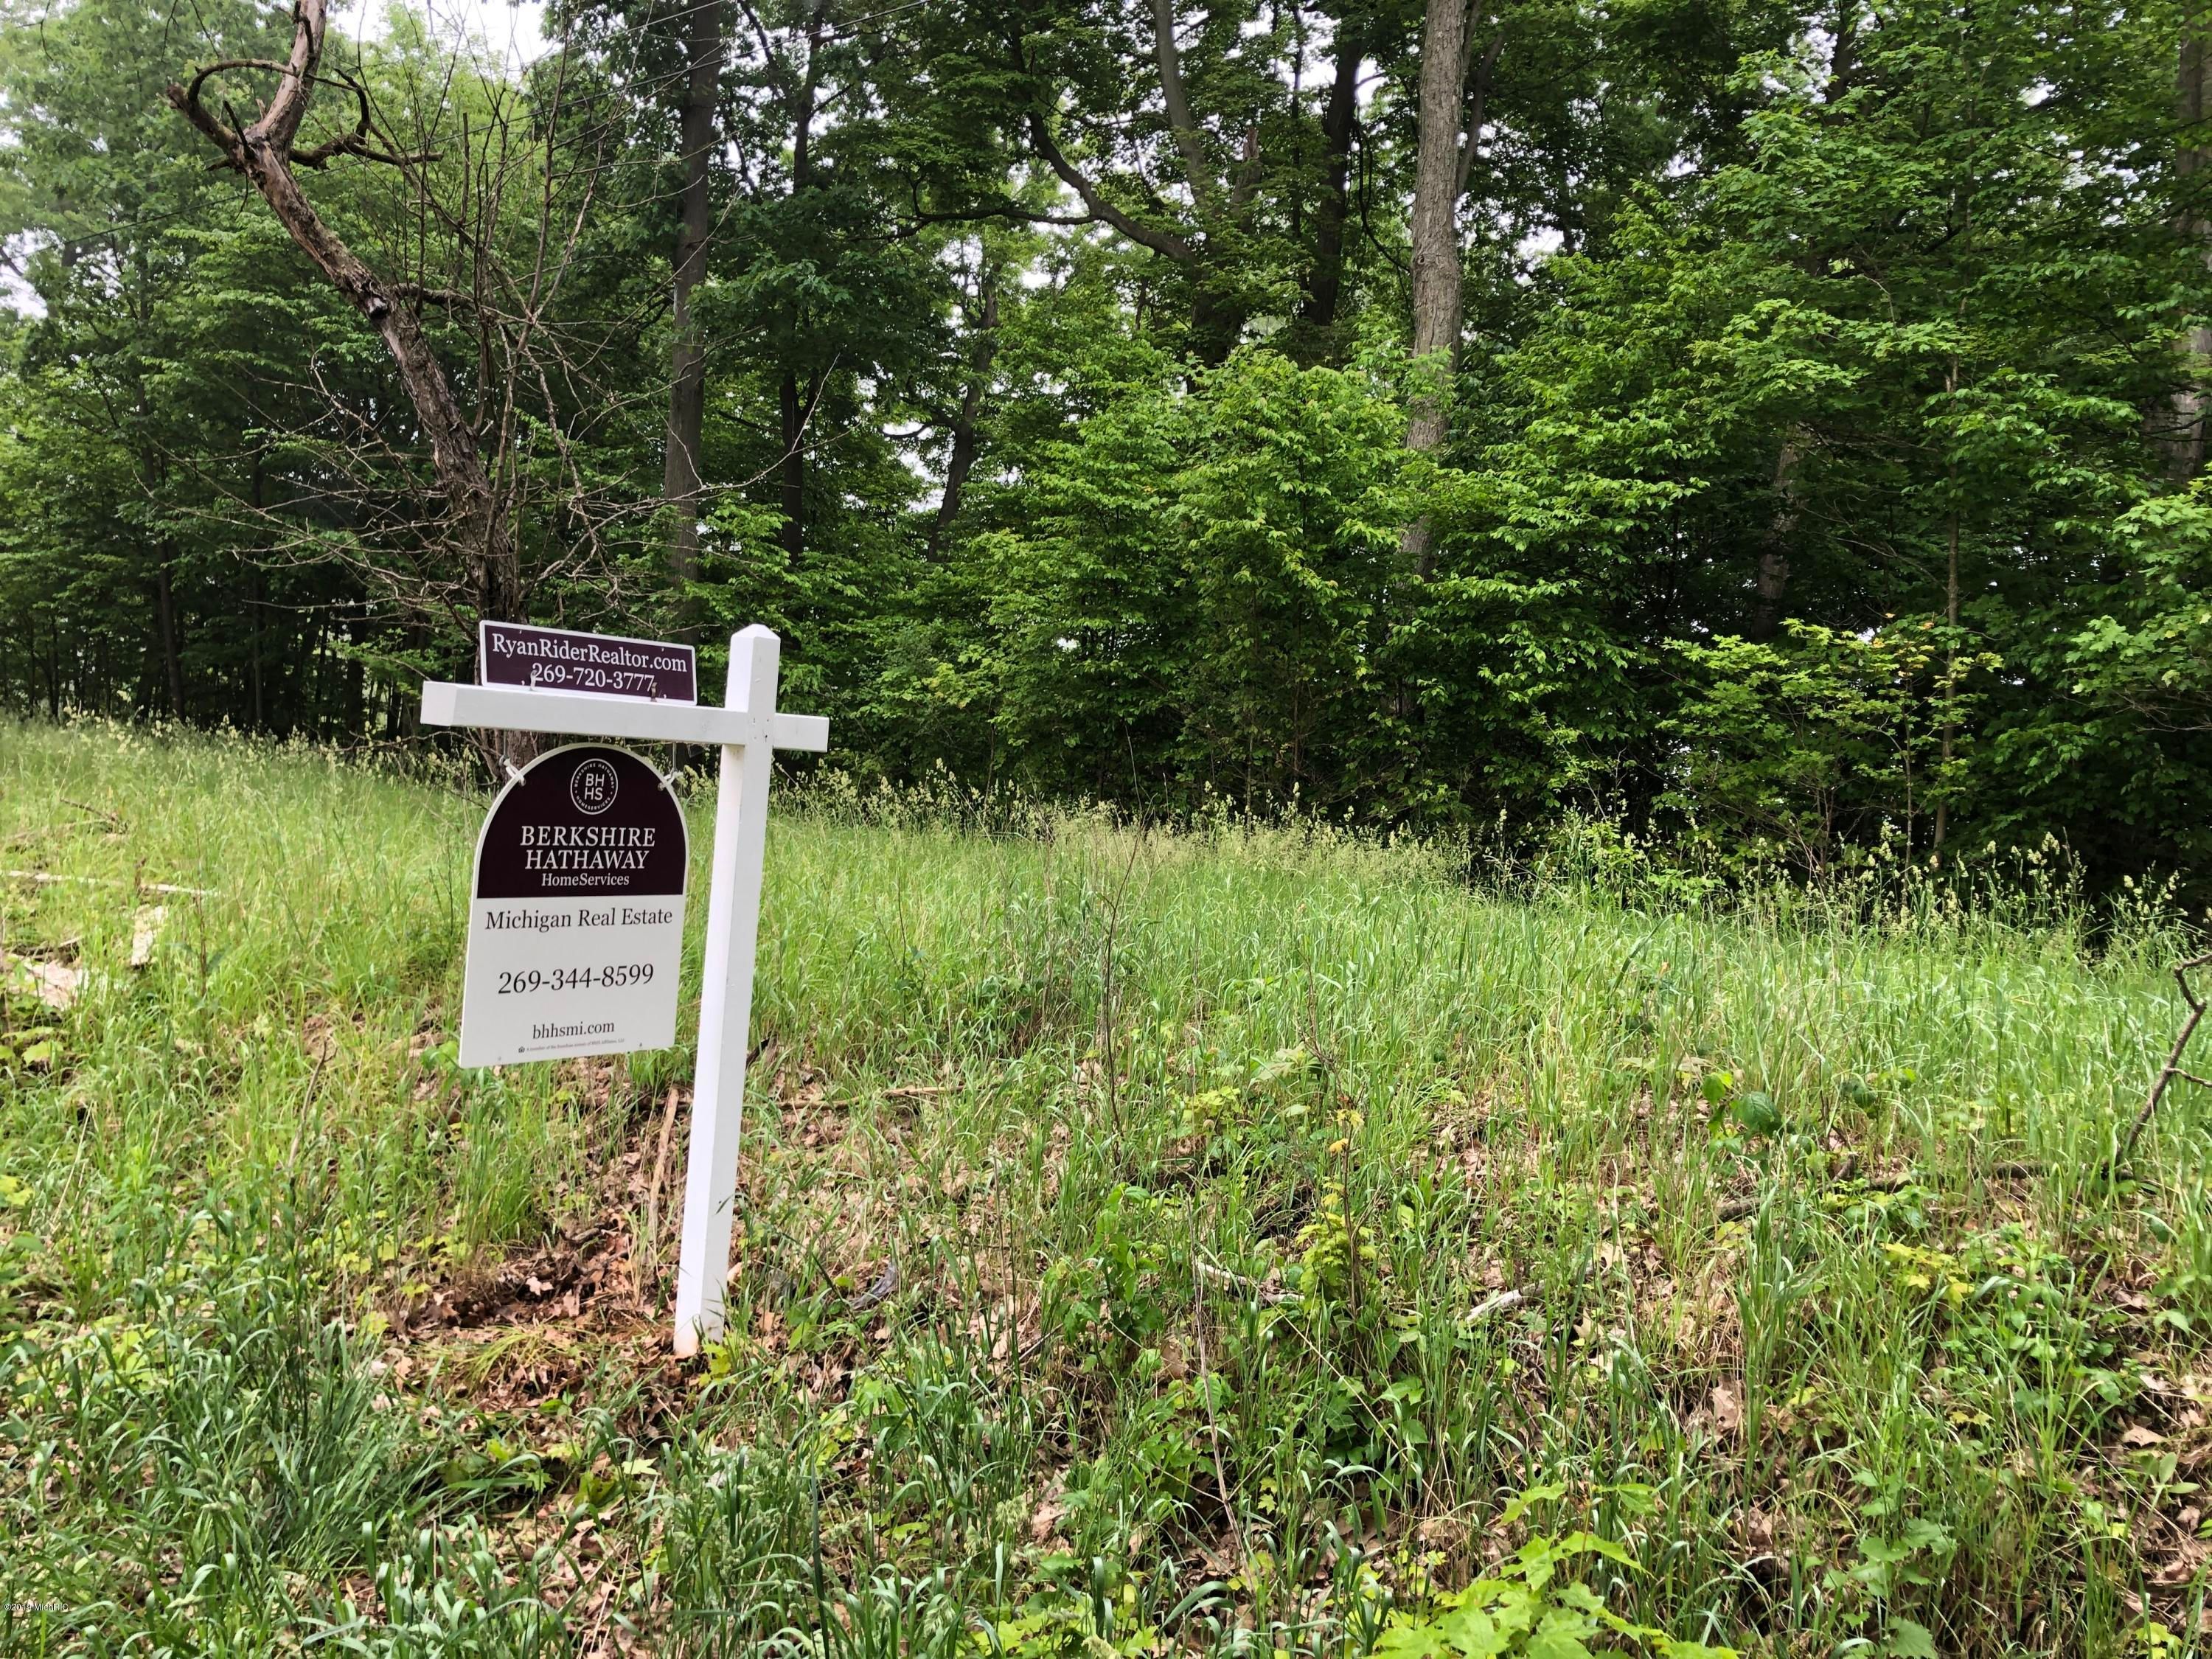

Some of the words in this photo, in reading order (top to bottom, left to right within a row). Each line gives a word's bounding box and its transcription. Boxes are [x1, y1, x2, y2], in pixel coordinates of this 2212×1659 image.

[492, 633, 688, 672] RyanRiderRealtor.com
[531, 662, 655, 692] 269-720-3777
[585, 773, 605, 787] BH
[584, 787, 603, 801] HS
[520, 825, 655, 847] BERKSHIRE
[525, 849, 649, 869] HATHAWAY
[541, 872, 630, 886] HomeServices
[485, 909, 571, 933] Michigan
[577, 908, 616, 927] Real
[621, 908, 673, 925] Estate
[498, 963, 654, 995] 269-344-8599
[532, 1021, 614, 1040] bhhsmi.com
